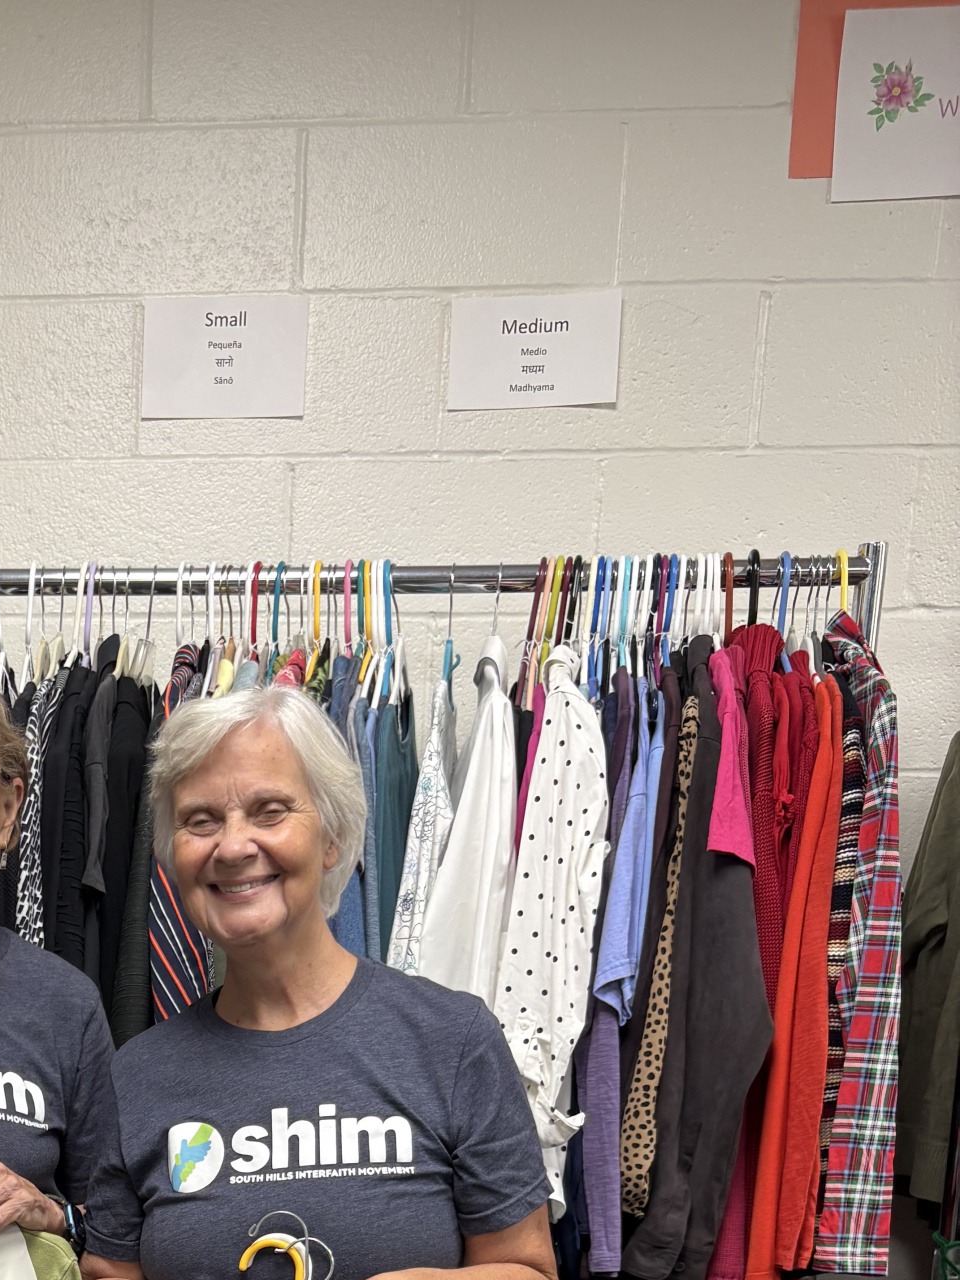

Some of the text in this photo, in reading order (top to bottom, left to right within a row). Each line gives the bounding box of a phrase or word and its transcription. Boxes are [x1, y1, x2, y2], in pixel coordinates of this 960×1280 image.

[204, 310, 247, 327] Small
[501, 318, 569, 335] Medium
[208, 340, 242, 350] Pequeña
[520, 347, 547, 356] Medio
[215, 355, 234, 368] सानो
[509, 383, 555, 393] Madhyama
[230, 1104, 413, 1173] shim
[229, 1166, 415, 1184] SOUTH HILLS INTERFAITH MOVEMENT
